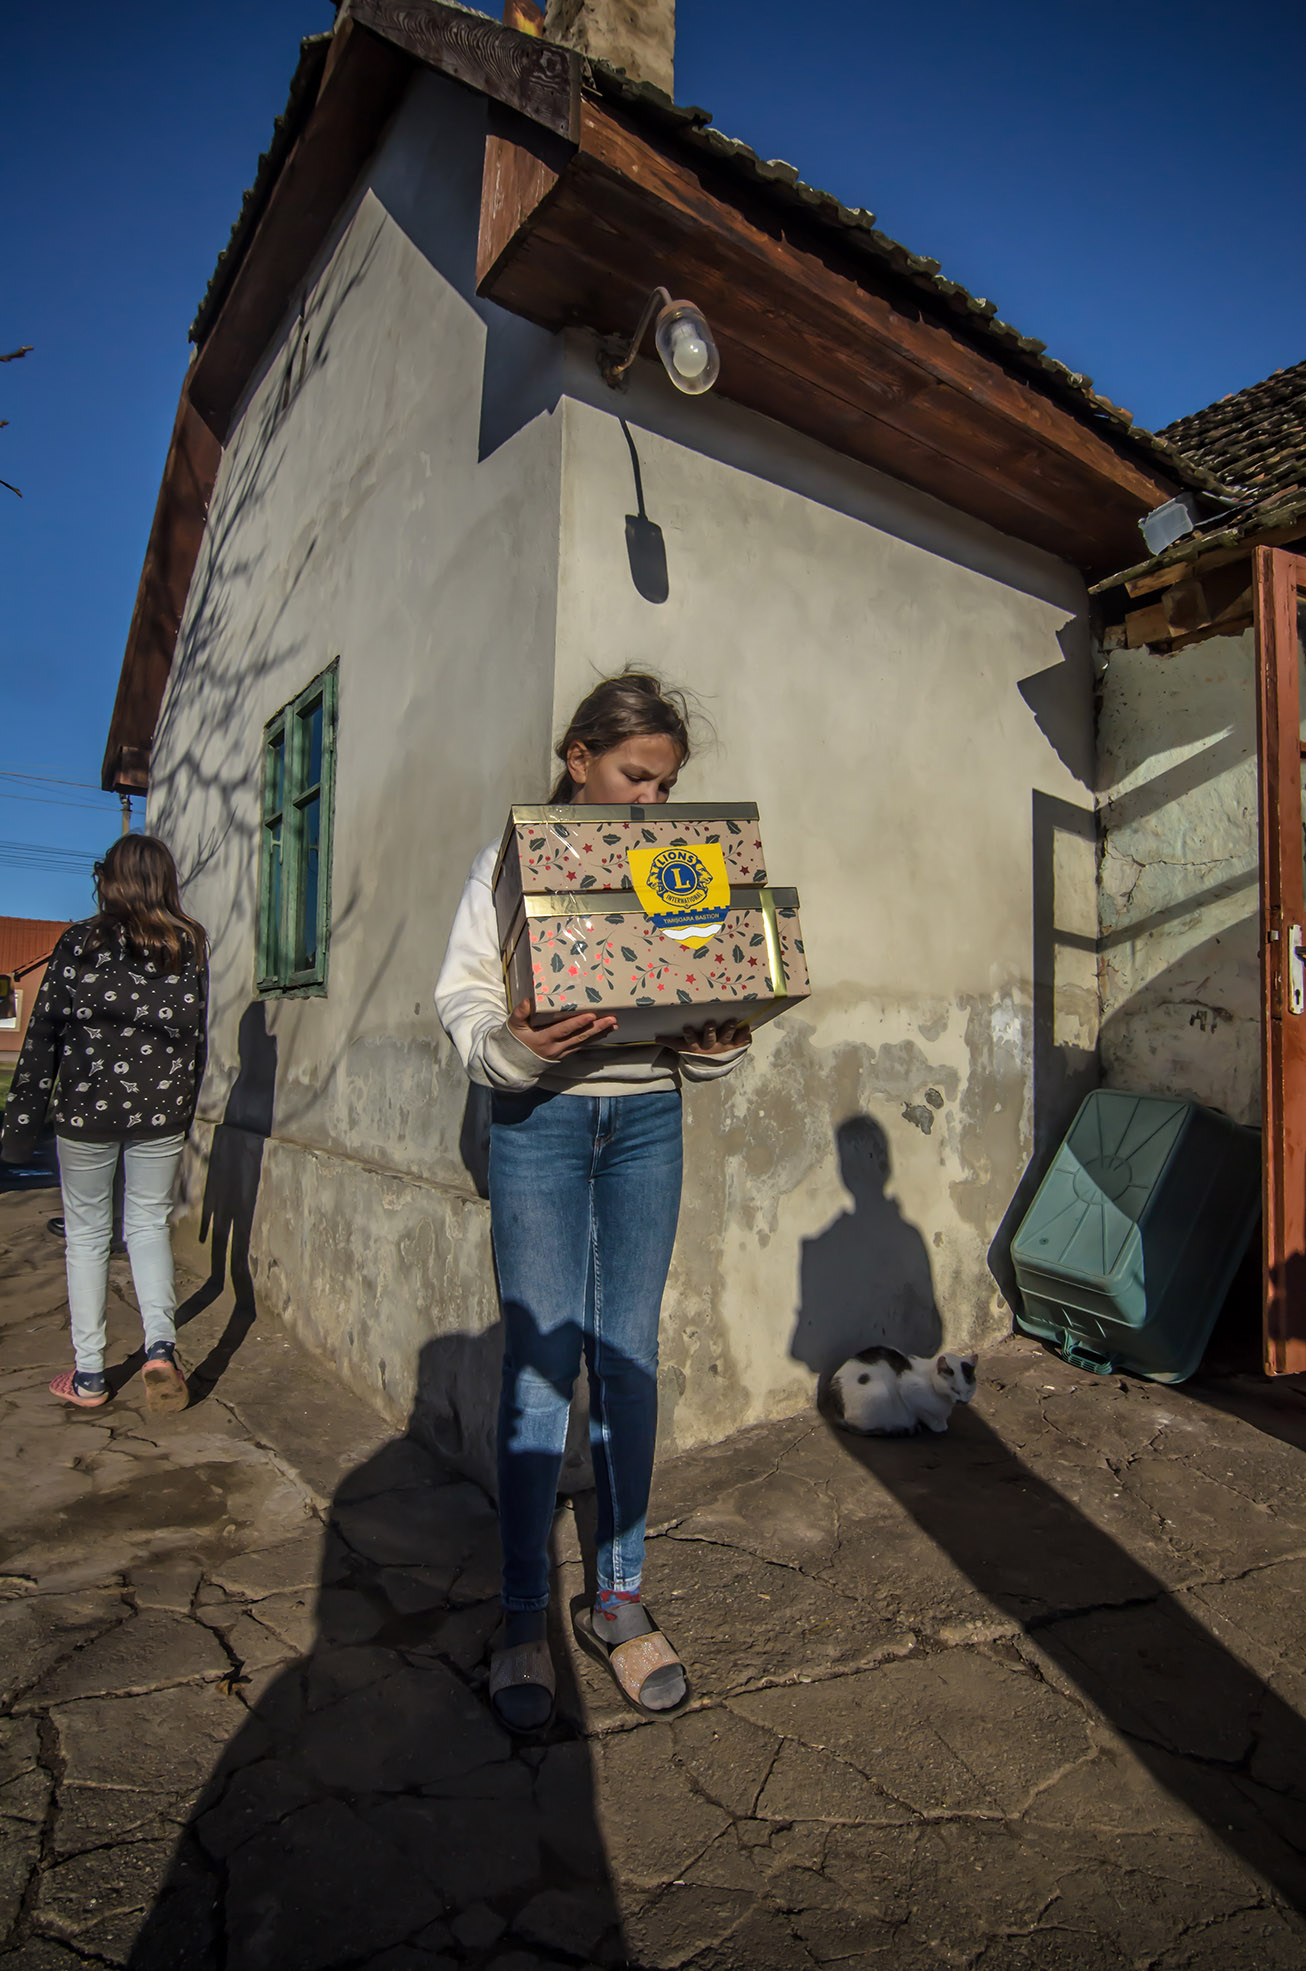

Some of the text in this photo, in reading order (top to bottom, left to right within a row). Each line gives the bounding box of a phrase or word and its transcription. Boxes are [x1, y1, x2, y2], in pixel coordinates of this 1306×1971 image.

[657, 851, 695, 865] LIONS
[671, 868, 691, 889] L
[665, 892, 703, 904] INTERNATIONAL
[695, 913, 720, 921] BASTION
